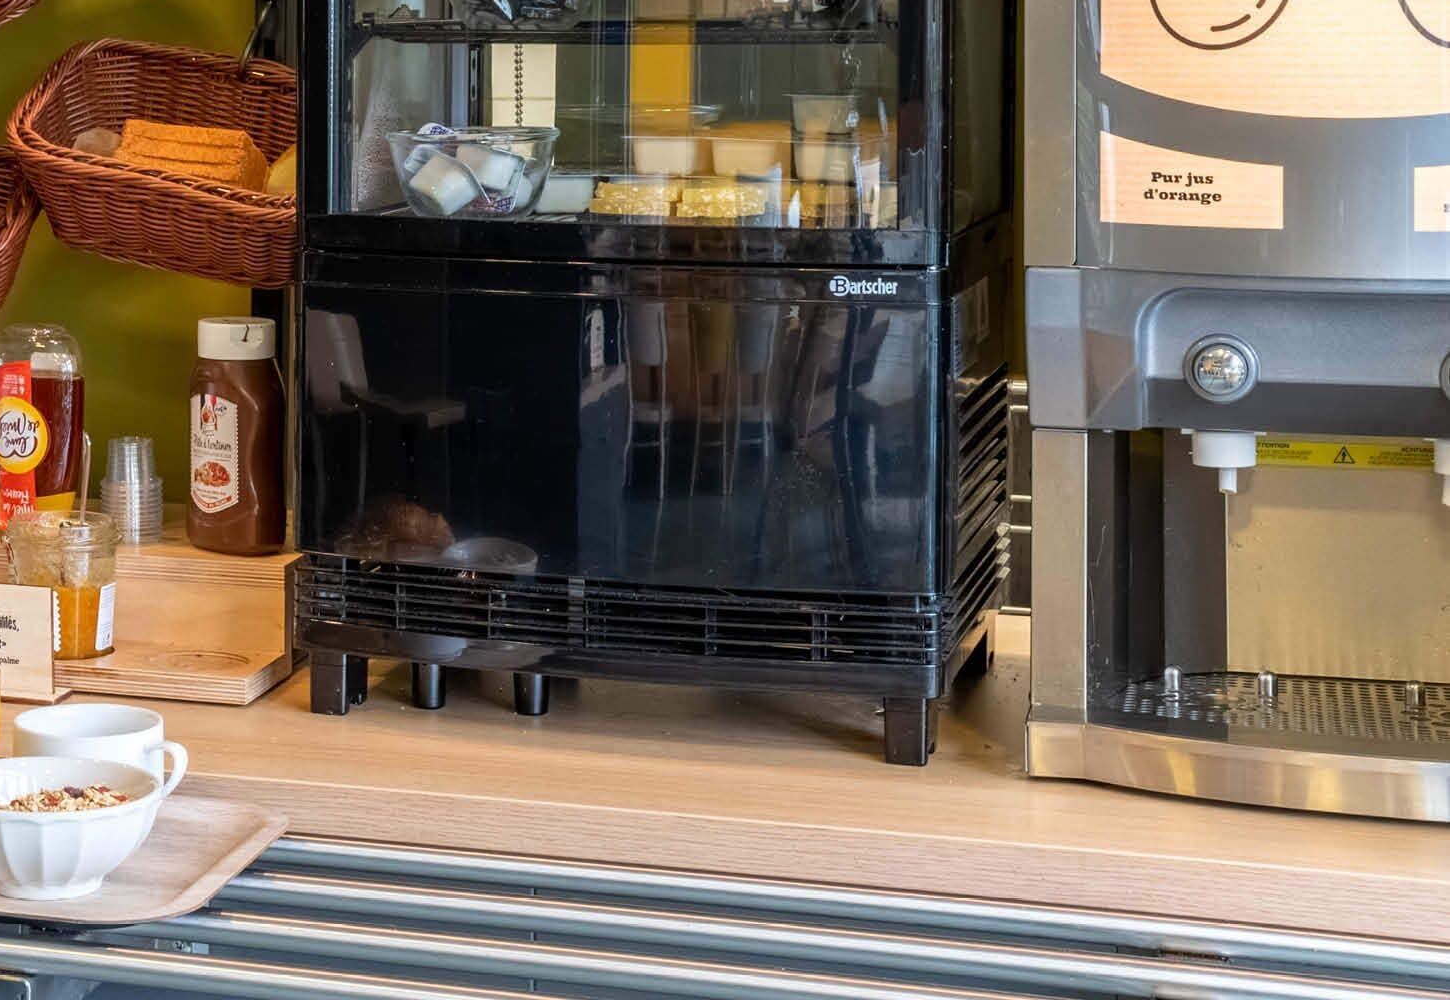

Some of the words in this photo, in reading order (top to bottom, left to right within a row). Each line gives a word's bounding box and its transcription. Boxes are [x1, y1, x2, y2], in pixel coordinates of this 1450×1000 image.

[1151, 172, 1182, 183] Pur
[1185, 172, 1214, 187] jus
[1144, 189, 1222, 205] d'orange
[829, 275, 898, 296] Bartscher
[0, 657, 19, 665] palme
